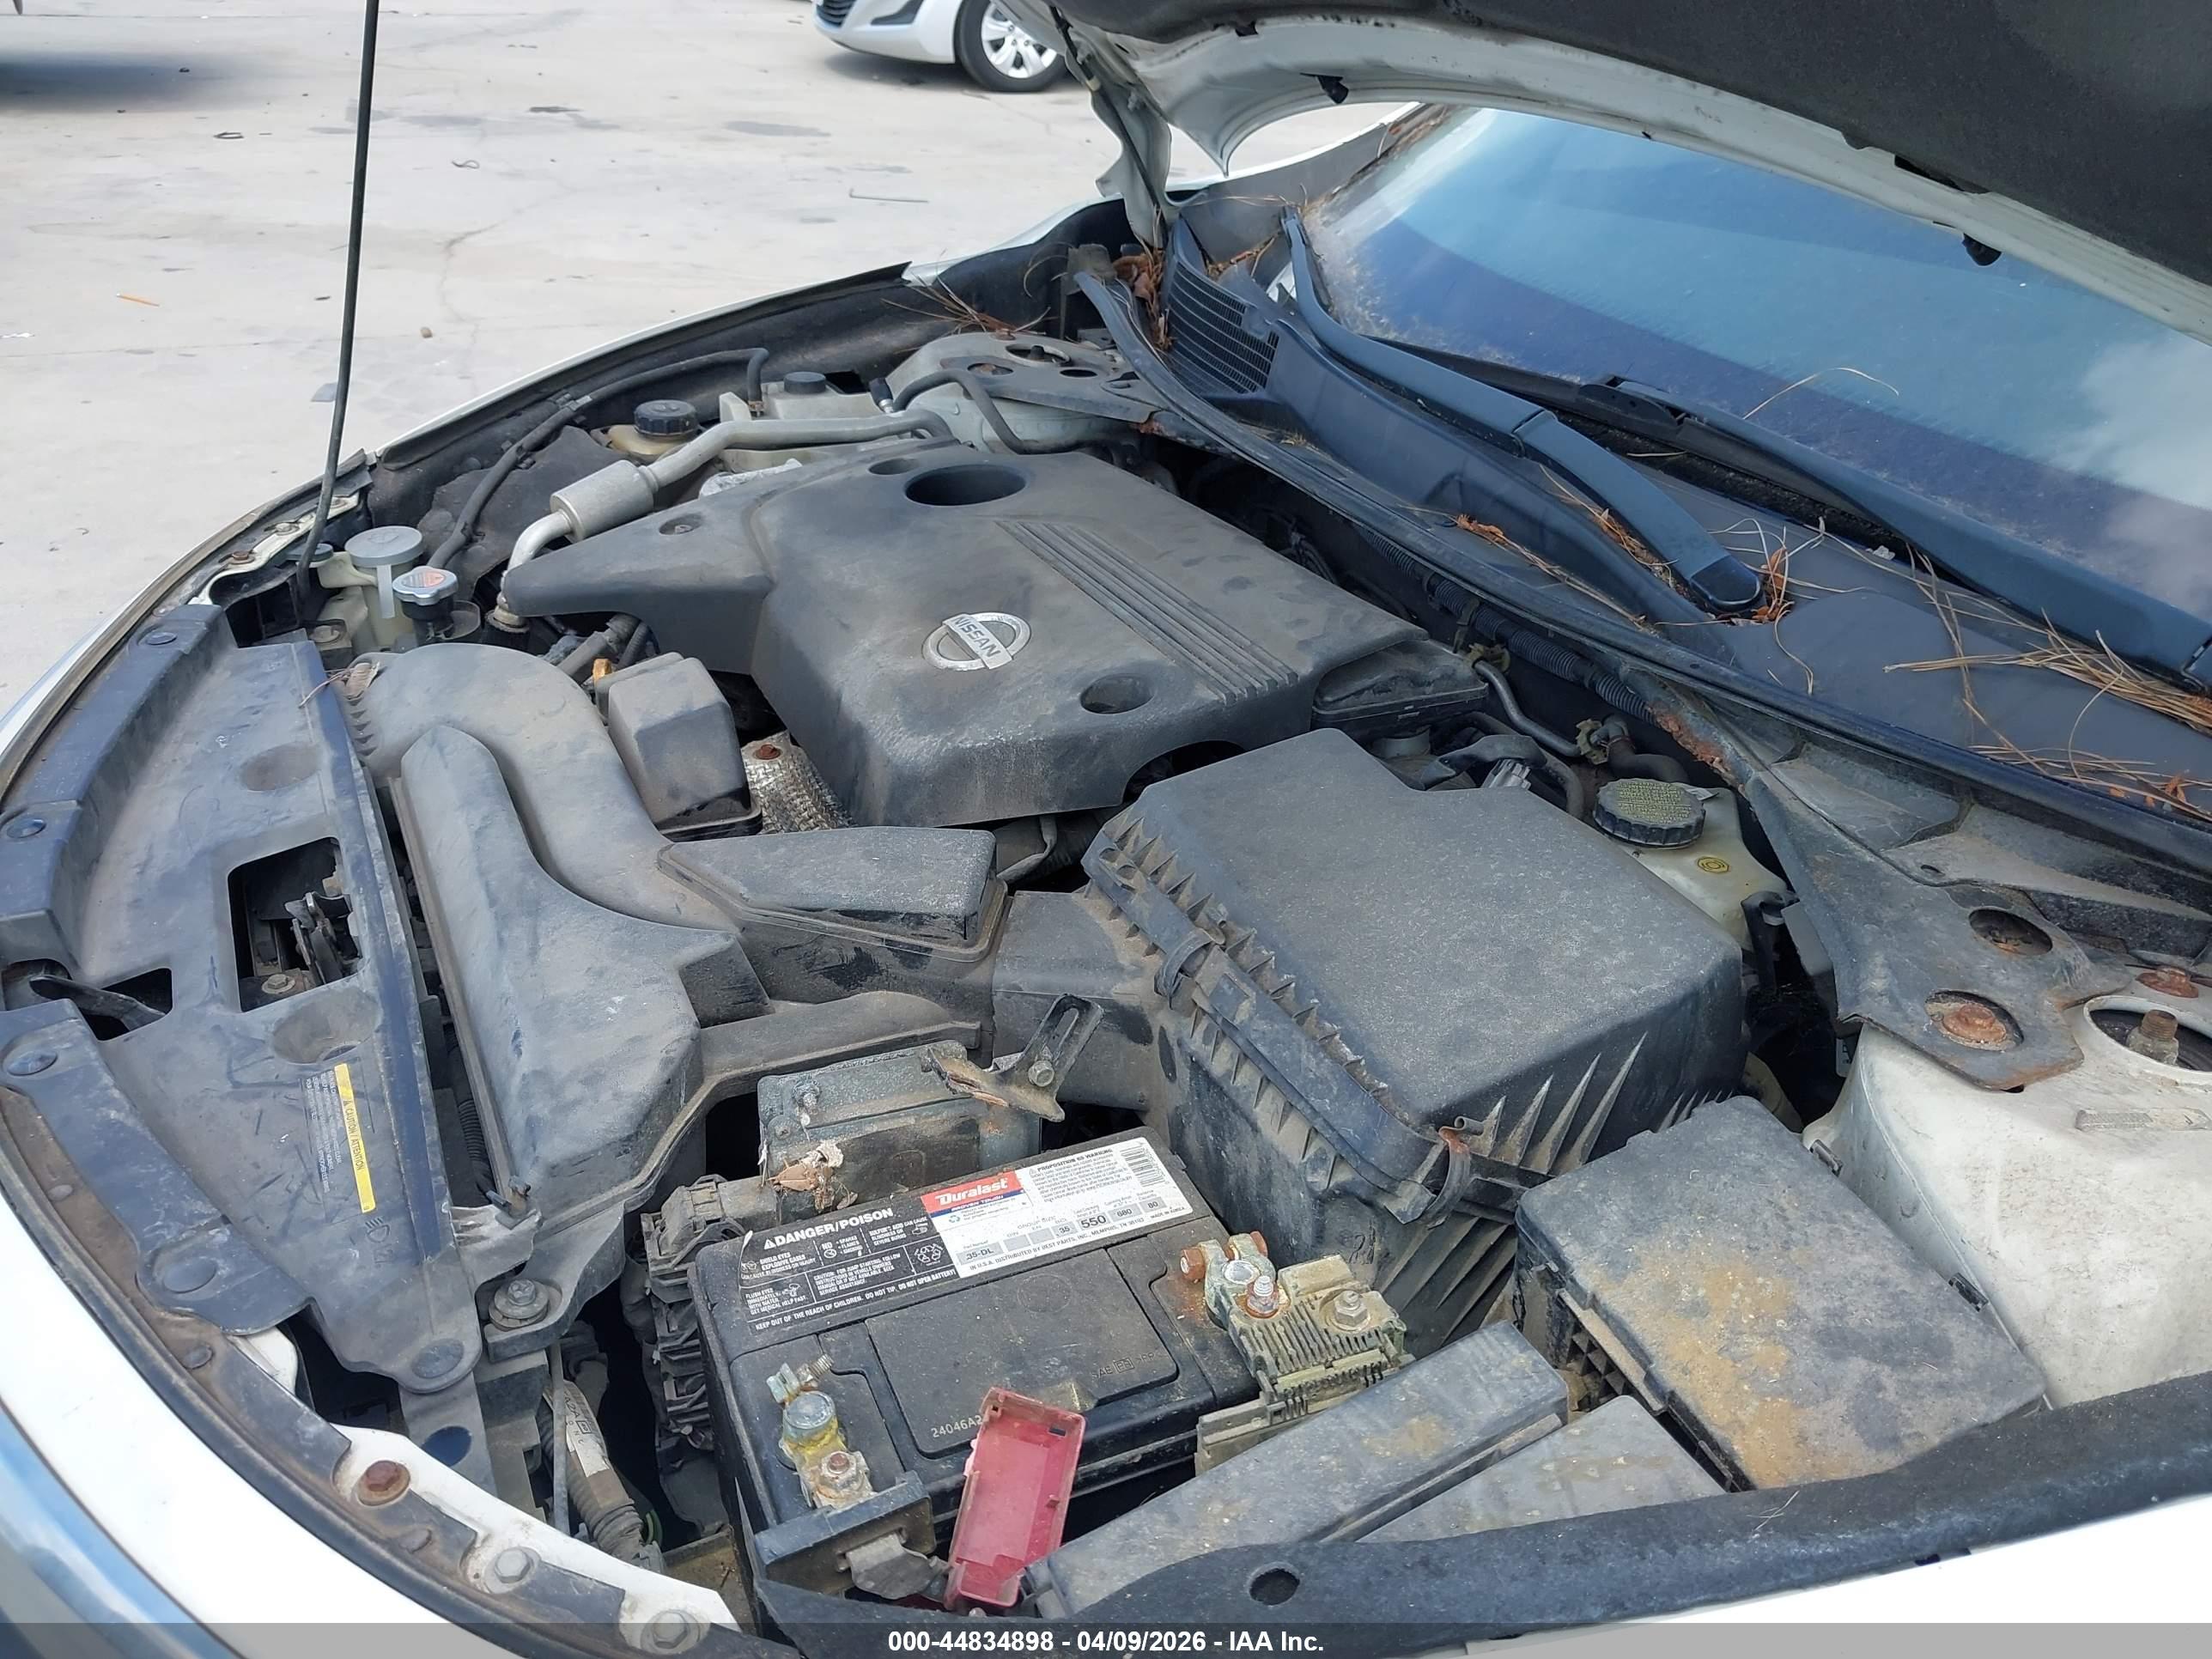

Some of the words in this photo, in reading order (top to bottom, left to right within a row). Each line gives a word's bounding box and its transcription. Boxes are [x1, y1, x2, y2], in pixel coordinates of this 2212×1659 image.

[954, 617, 1001, 658] NISSAN
[345, 1108, 358, 1134] CAUTION
[350, 1139, 365, 1171] ATTENTION
[935, 1178, 1008, 1205] Duralast
[774, 1208, 894, 1247] DANGER/POISON
[1080, 1216, 1107, 1228] 550
[883, 1253, 900, 1261] FOLLOW
[966, 1248, 994, 1260] 35-DL
[756, 1321, 770, 1331] KEEP
[771, 1317, 783, 1326] OUT
[784, 1315, 792, 1323] OF
[793, 1310, 805, 1320] THE
[805, 1305, 824, 1316] REACH
[825, 1302, 833, 1311] OF
[865, 1290, 874, 1299] DO
[875, 1287, 886, 1297] NOT
[931, 1414, 982, 1437] 24046A2
